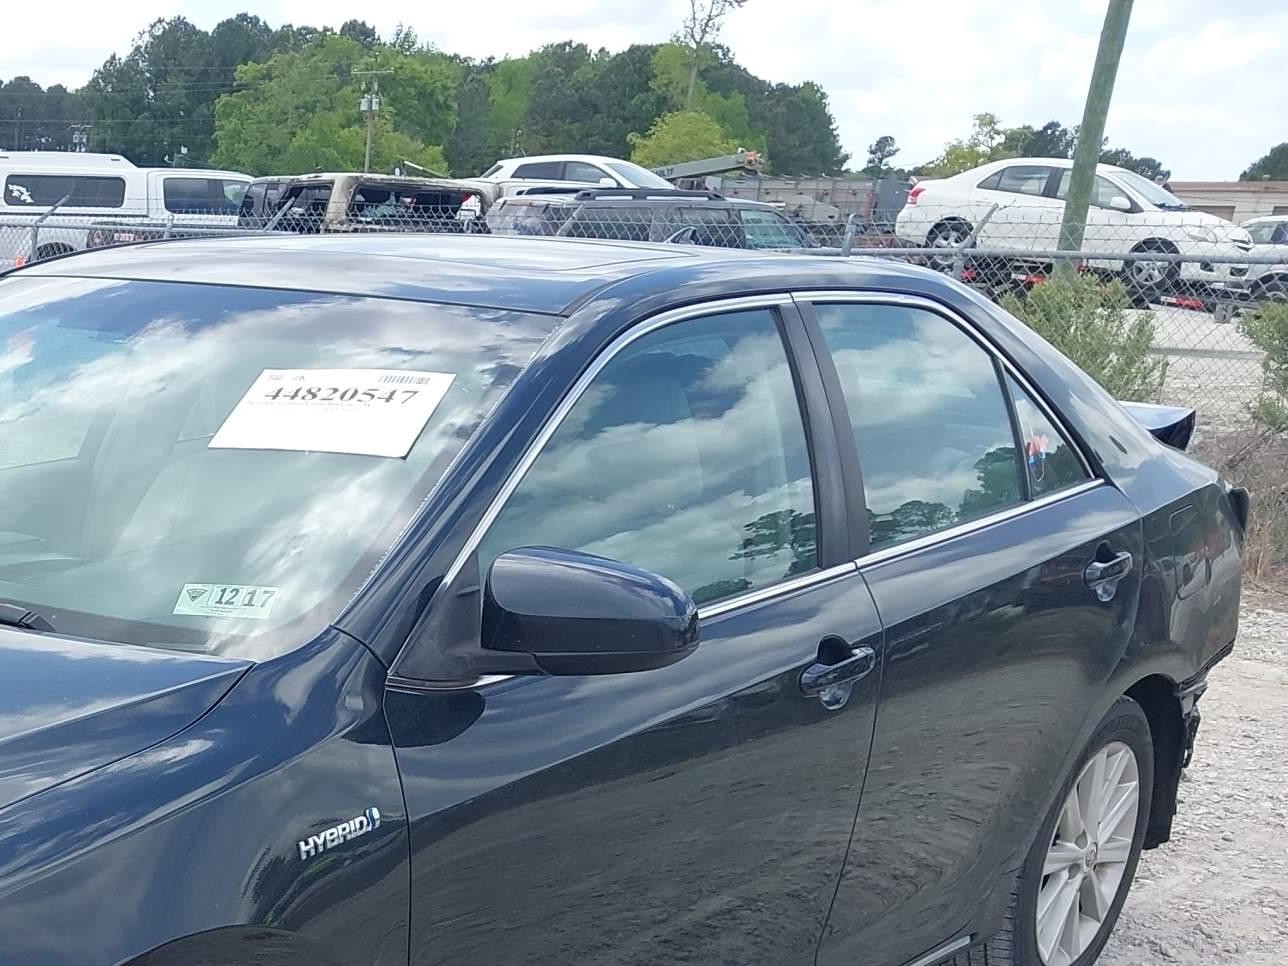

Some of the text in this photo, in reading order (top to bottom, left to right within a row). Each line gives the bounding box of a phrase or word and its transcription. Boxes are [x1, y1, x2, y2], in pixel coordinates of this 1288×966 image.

[264, 386, 420, 405] 44820547
[215, 587, 276, 607] 12 17
[298, 815, 369, 861] HYBRID
